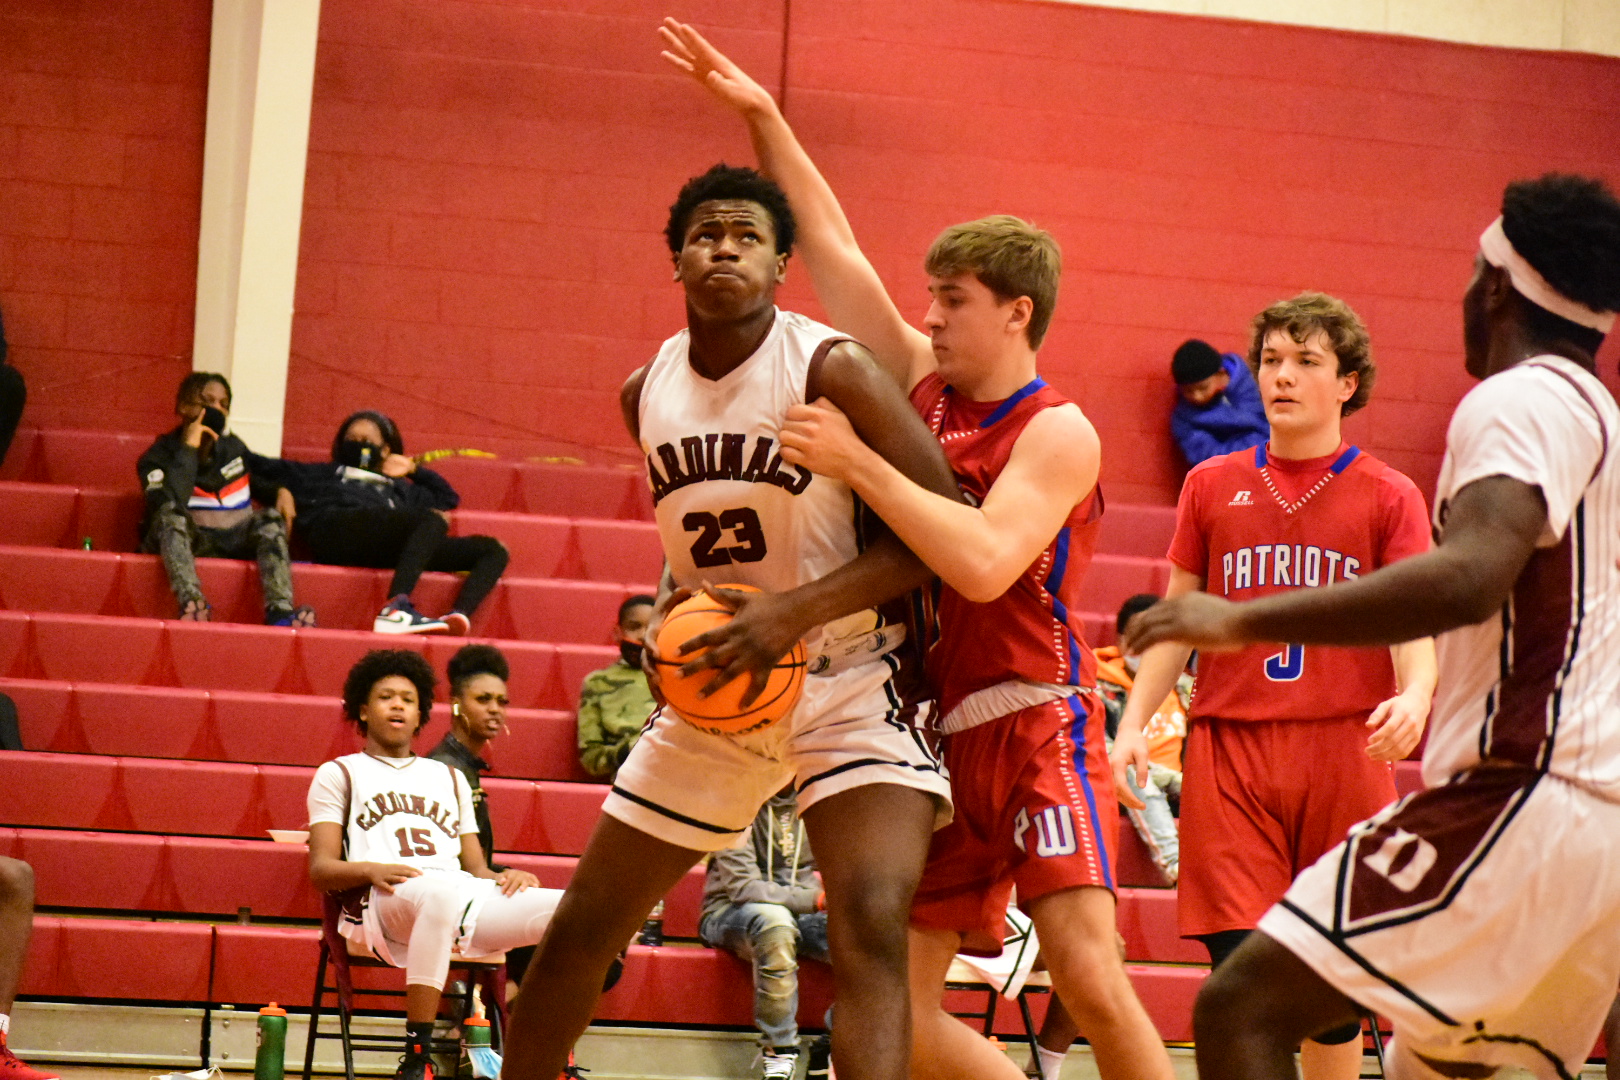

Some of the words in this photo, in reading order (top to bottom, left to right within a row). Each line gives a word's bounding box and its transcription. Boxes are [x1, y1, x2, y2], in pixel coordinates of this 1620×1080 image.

[648, 433, 812, 508] ARDINALS
[682, 507, 767, 568] 23
[1223, 543, 1361, 596] PATRIOTS
[356, 791, 460, 839] CARDINALS
[395, 827, 437, 857] 15
[1362, 827, 1438, 892] D
